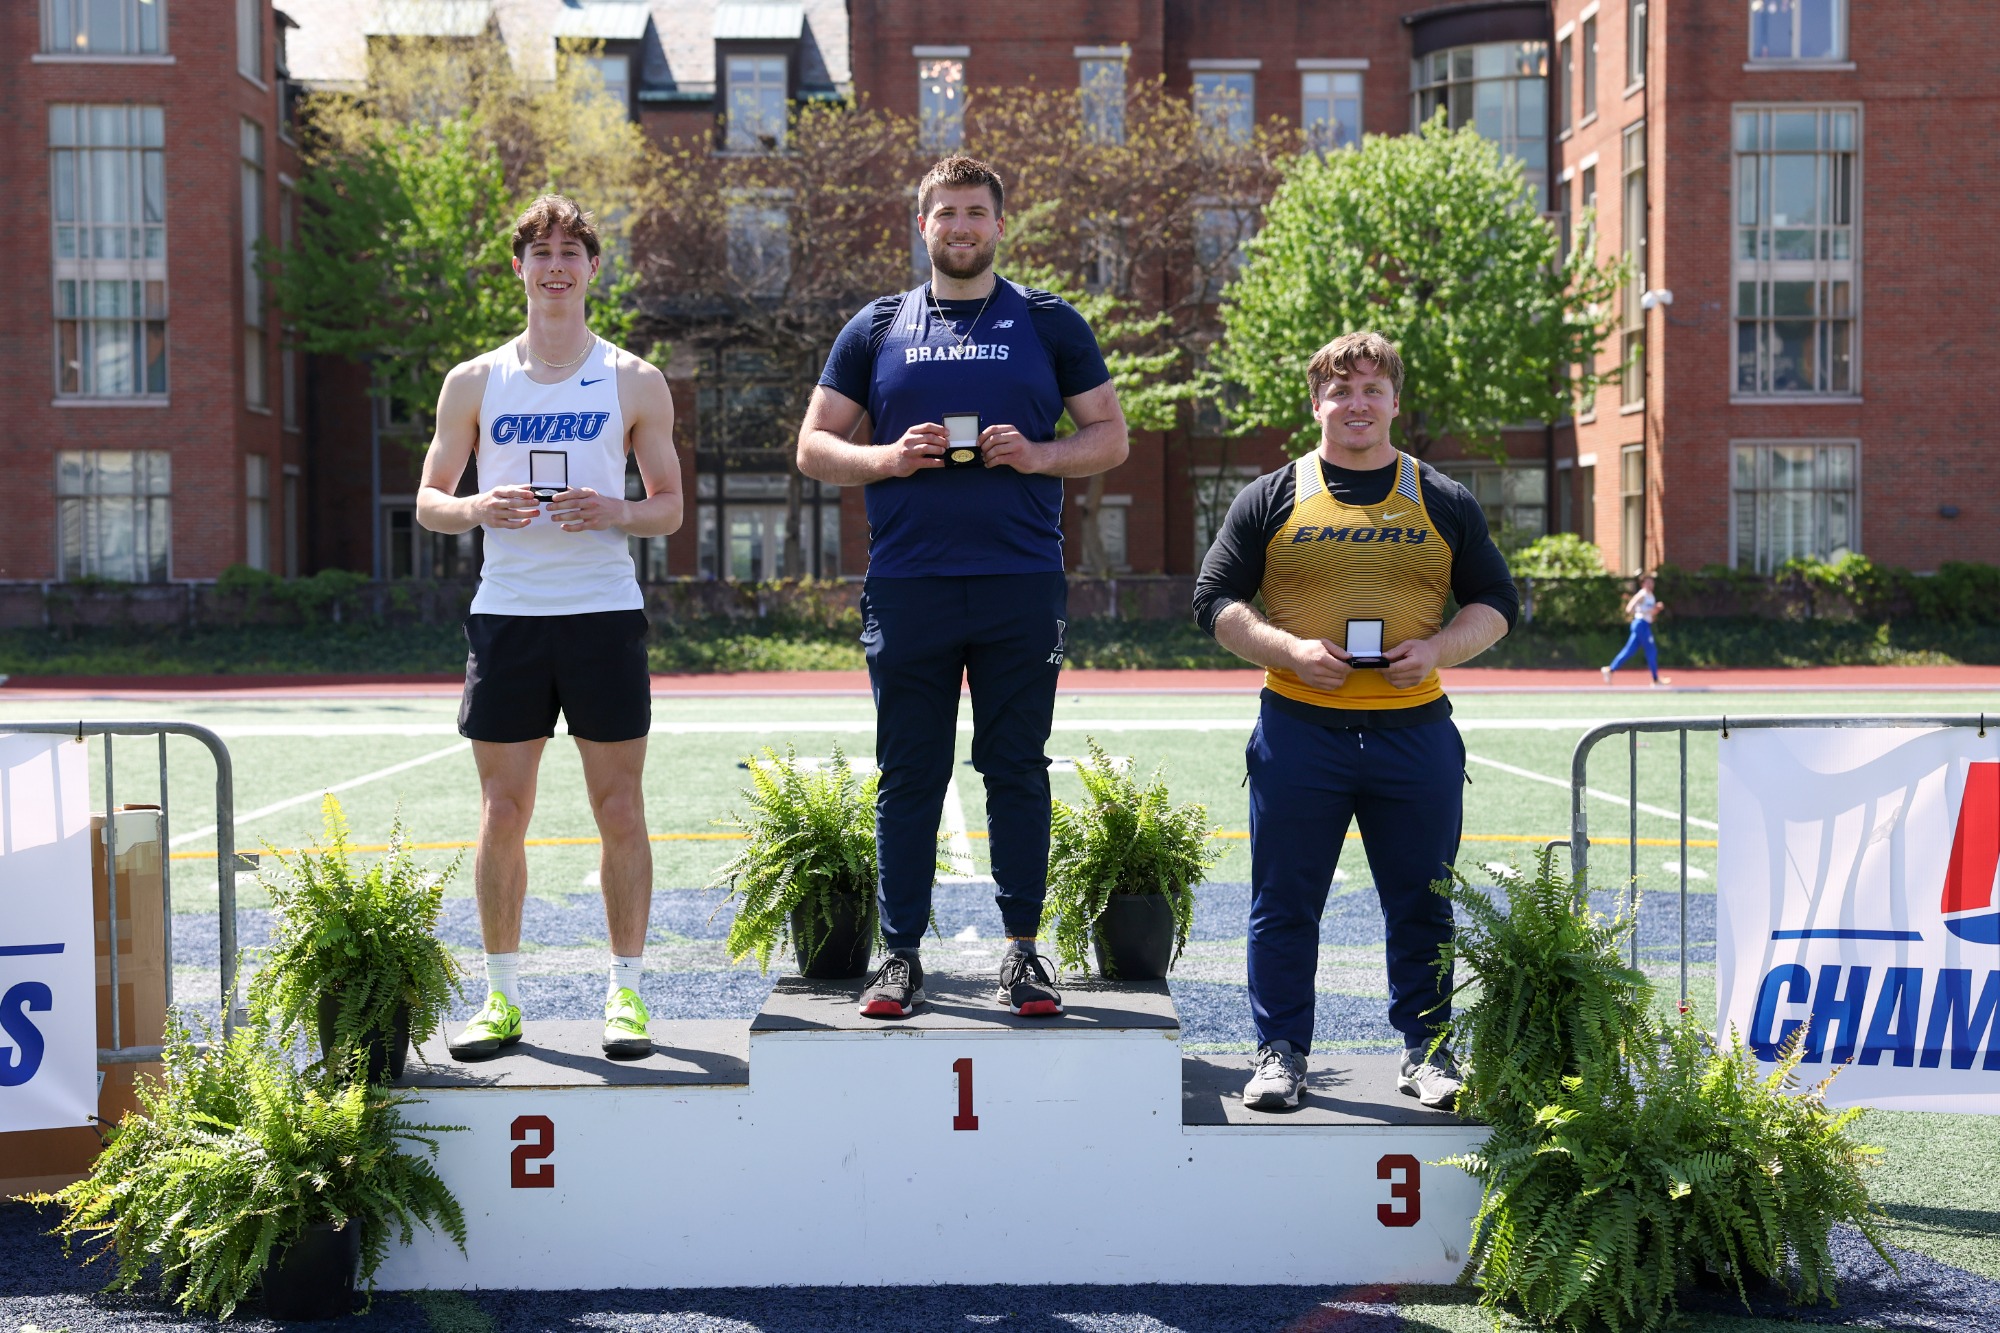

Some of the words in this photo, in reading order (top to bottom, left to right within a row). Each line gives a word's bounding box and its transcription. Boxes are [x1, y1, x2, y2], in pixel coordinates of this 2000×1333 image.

[905, 344, 1010, 365] BRANDEIS
[490, 411, 610, 445] CWRU
[1292, 526, 1428, 545] EMORY
[952, 1057, 979, 1131] 1
[510, 1115, 555, 1189] 2
[1376, 1153, 1421, 1228] 3
